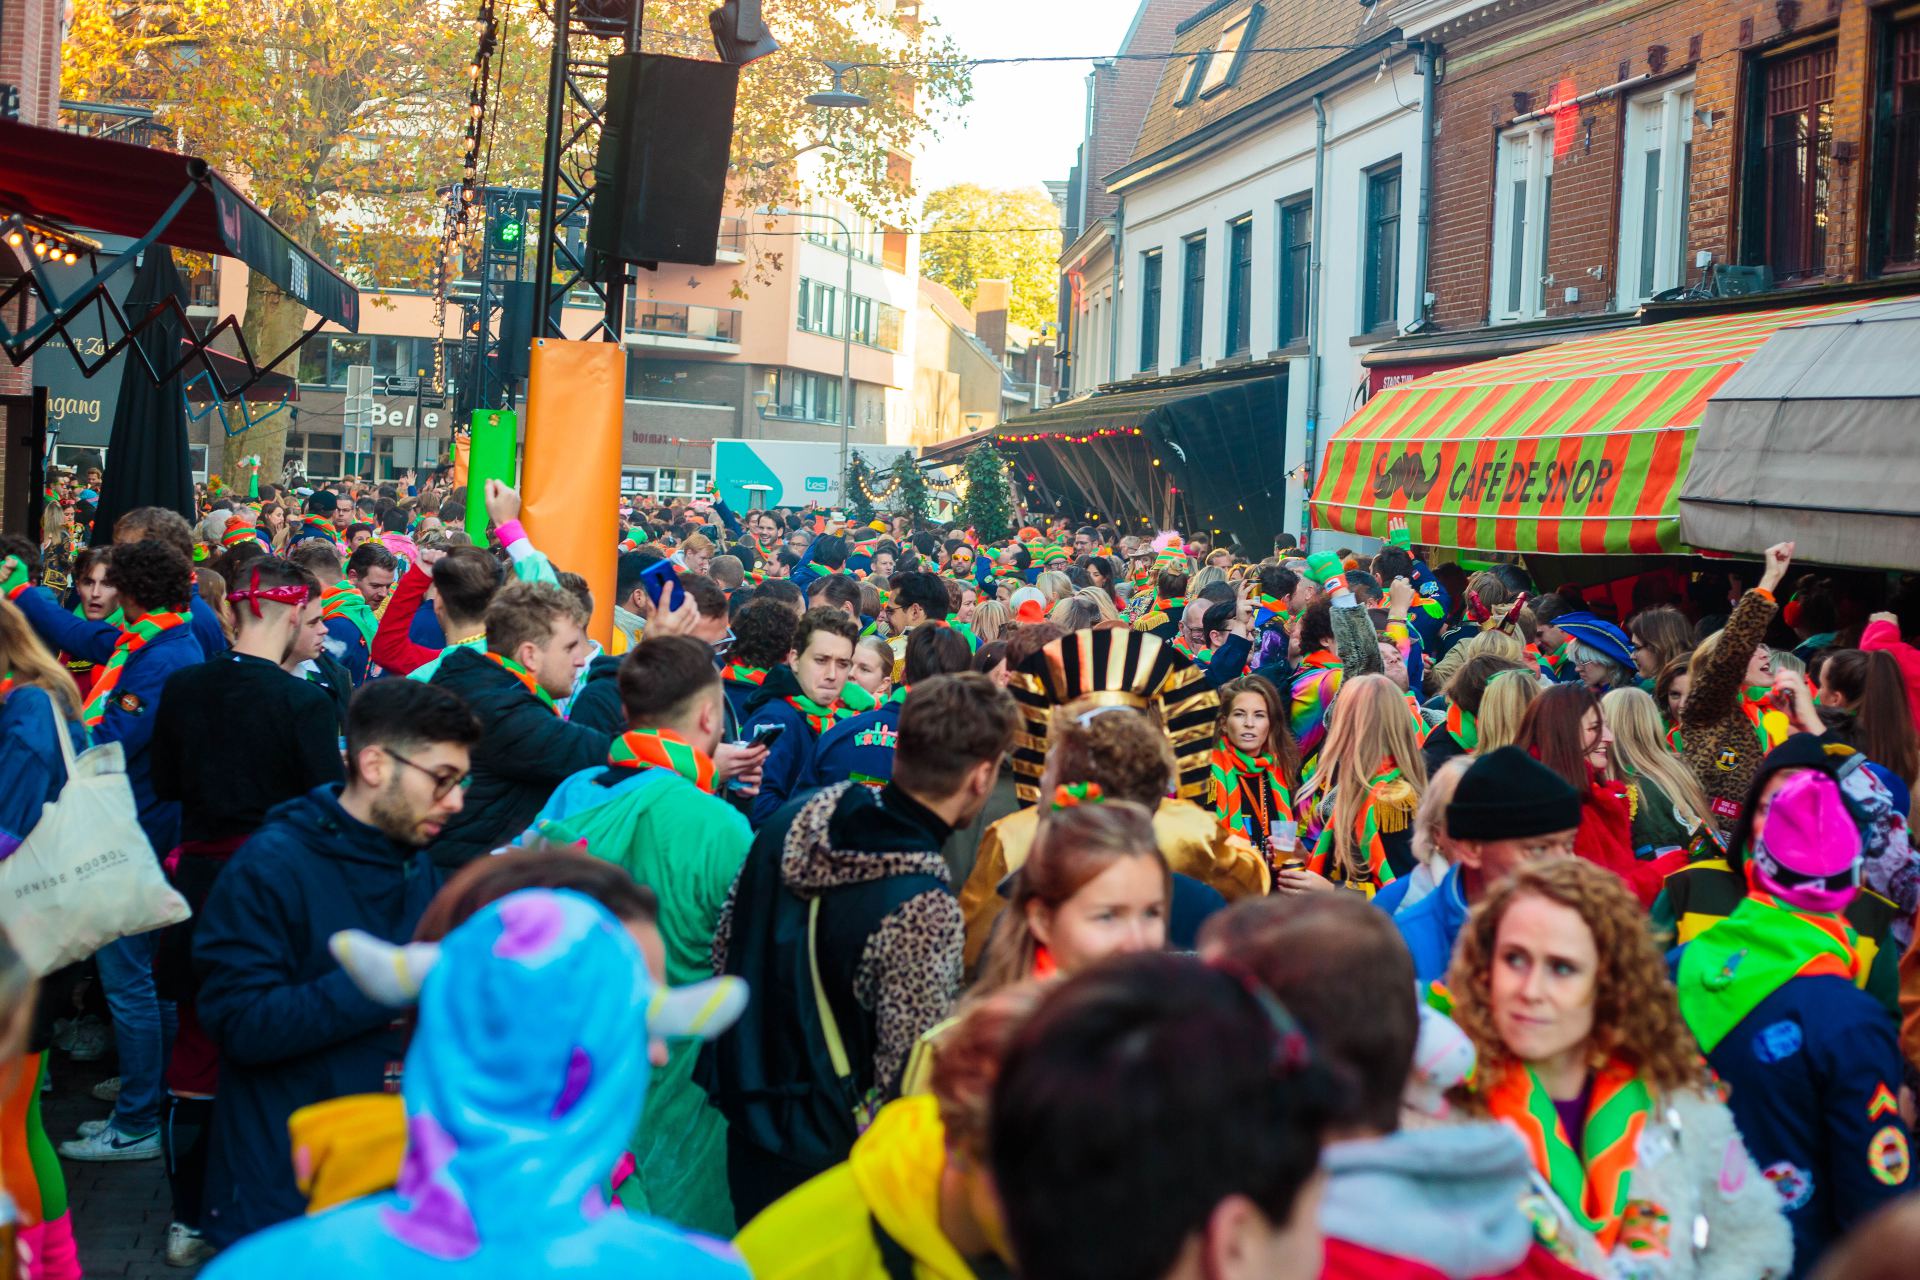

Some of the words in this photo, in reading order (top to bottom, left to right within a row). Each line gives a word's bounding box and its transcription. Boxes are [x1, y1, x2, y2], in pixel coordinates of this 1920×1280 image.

[47, 397, 101, 422] ngang
[372, 403, 439, 428] Bele
[1450, 450, 1507, 503] CAFÉ
[1502, 461, 1540, 503] DE
[1537, 459, 1613, 504] SNOR
[854, 733, 897, 749] KRUIK
[15, 873, 67, 899] DENISE
[74, 848, 128, 875] ROOBOL
